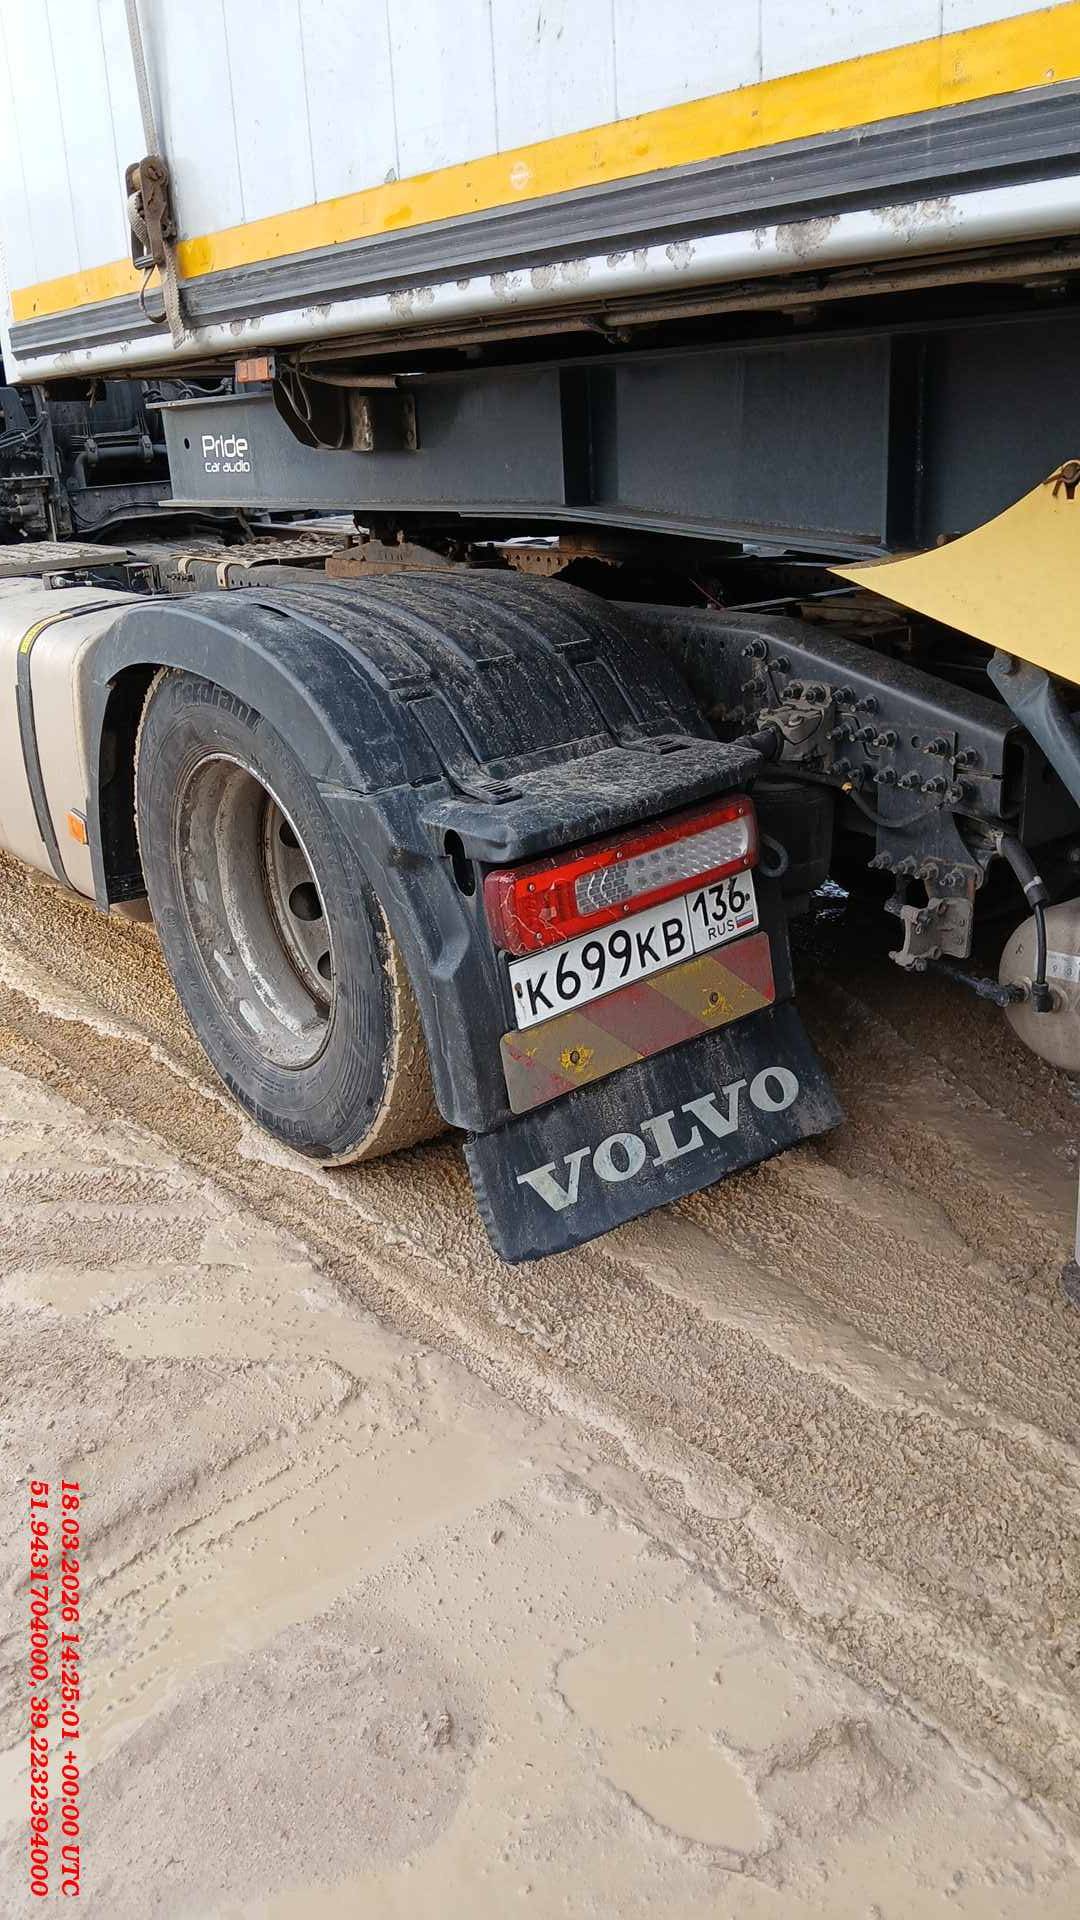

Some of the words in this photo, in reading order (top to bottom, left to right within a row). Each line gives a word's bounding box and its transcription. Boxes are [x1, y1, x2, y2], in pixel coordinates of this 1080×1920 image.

[202, 434, 248, 458] Pride
[204, 461, 220, 473] car
[222, 459, 250, 473] audio
[692, 877, 745, 927] 136
[708, 920, 735, 941] RUS
[517, 1066, 800, 1212] VOLVO
